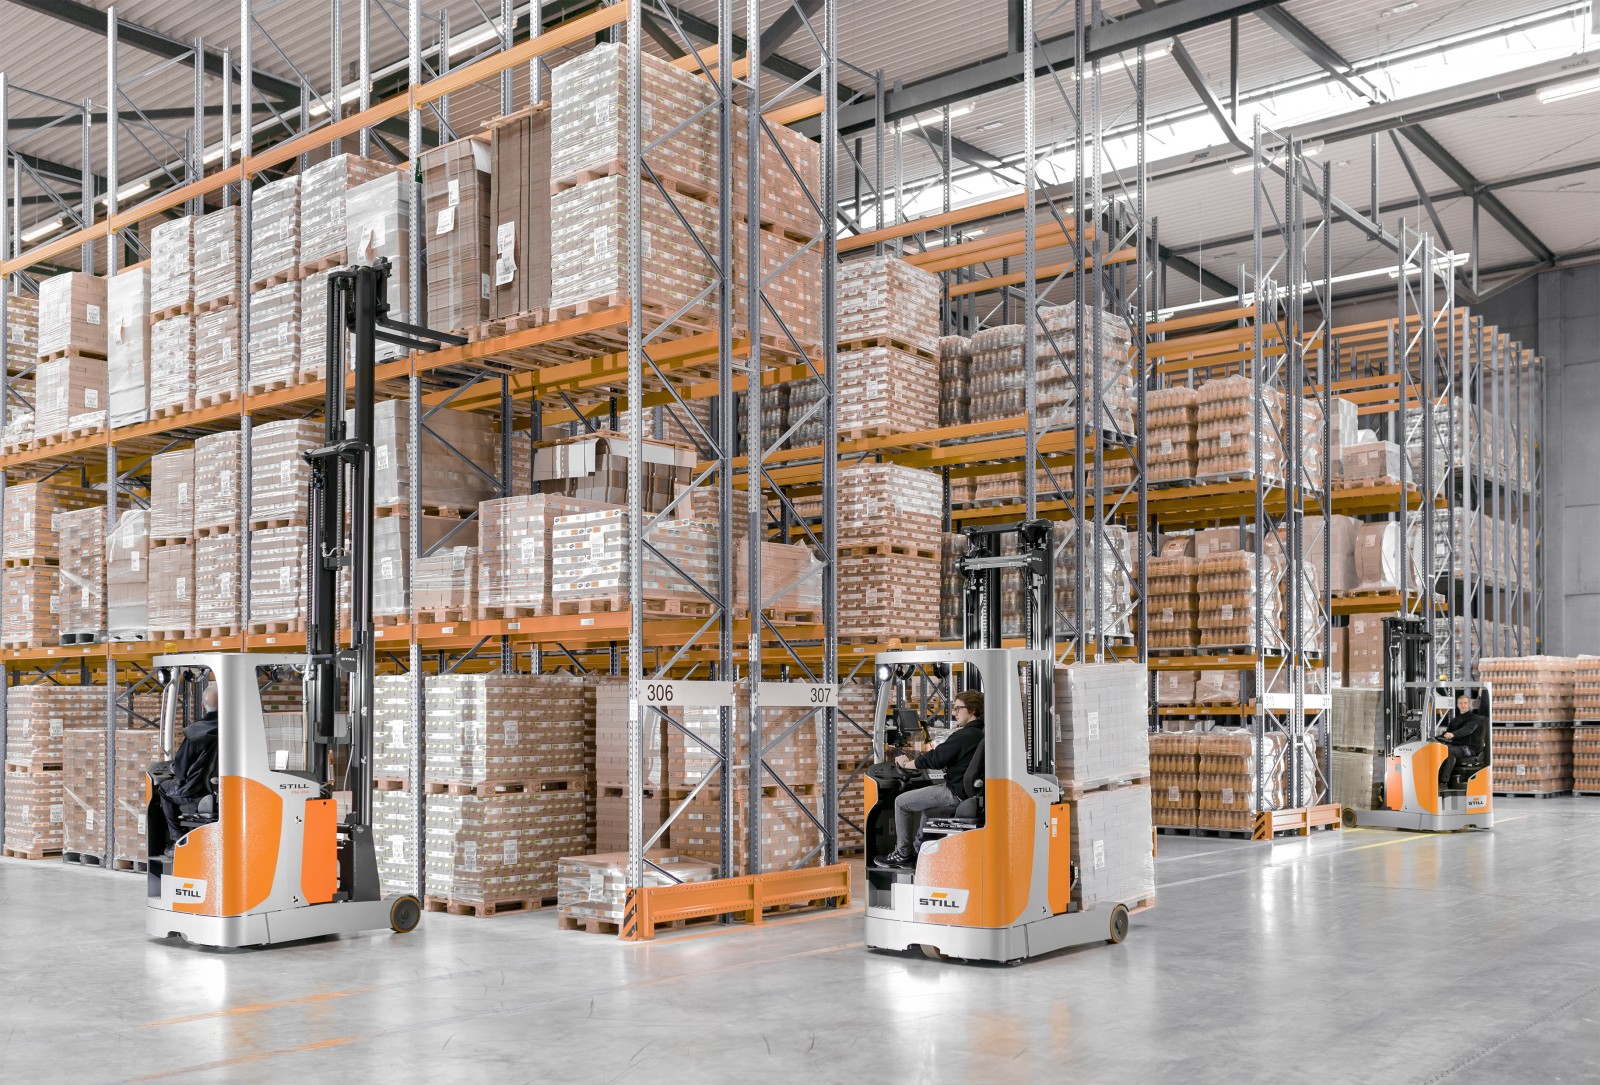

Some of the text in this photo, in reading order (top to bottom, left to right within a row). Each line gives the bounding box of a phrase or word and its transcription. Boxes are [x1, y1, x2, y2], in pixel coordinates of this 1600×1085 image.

[647, 684, 674, 701] 306
[810, 687, 831, 703] 307
[1033, 786, 1053, 794] STILL
[175, 888, 202, 898] STILL
[919, 897, 960, 909] STILL
